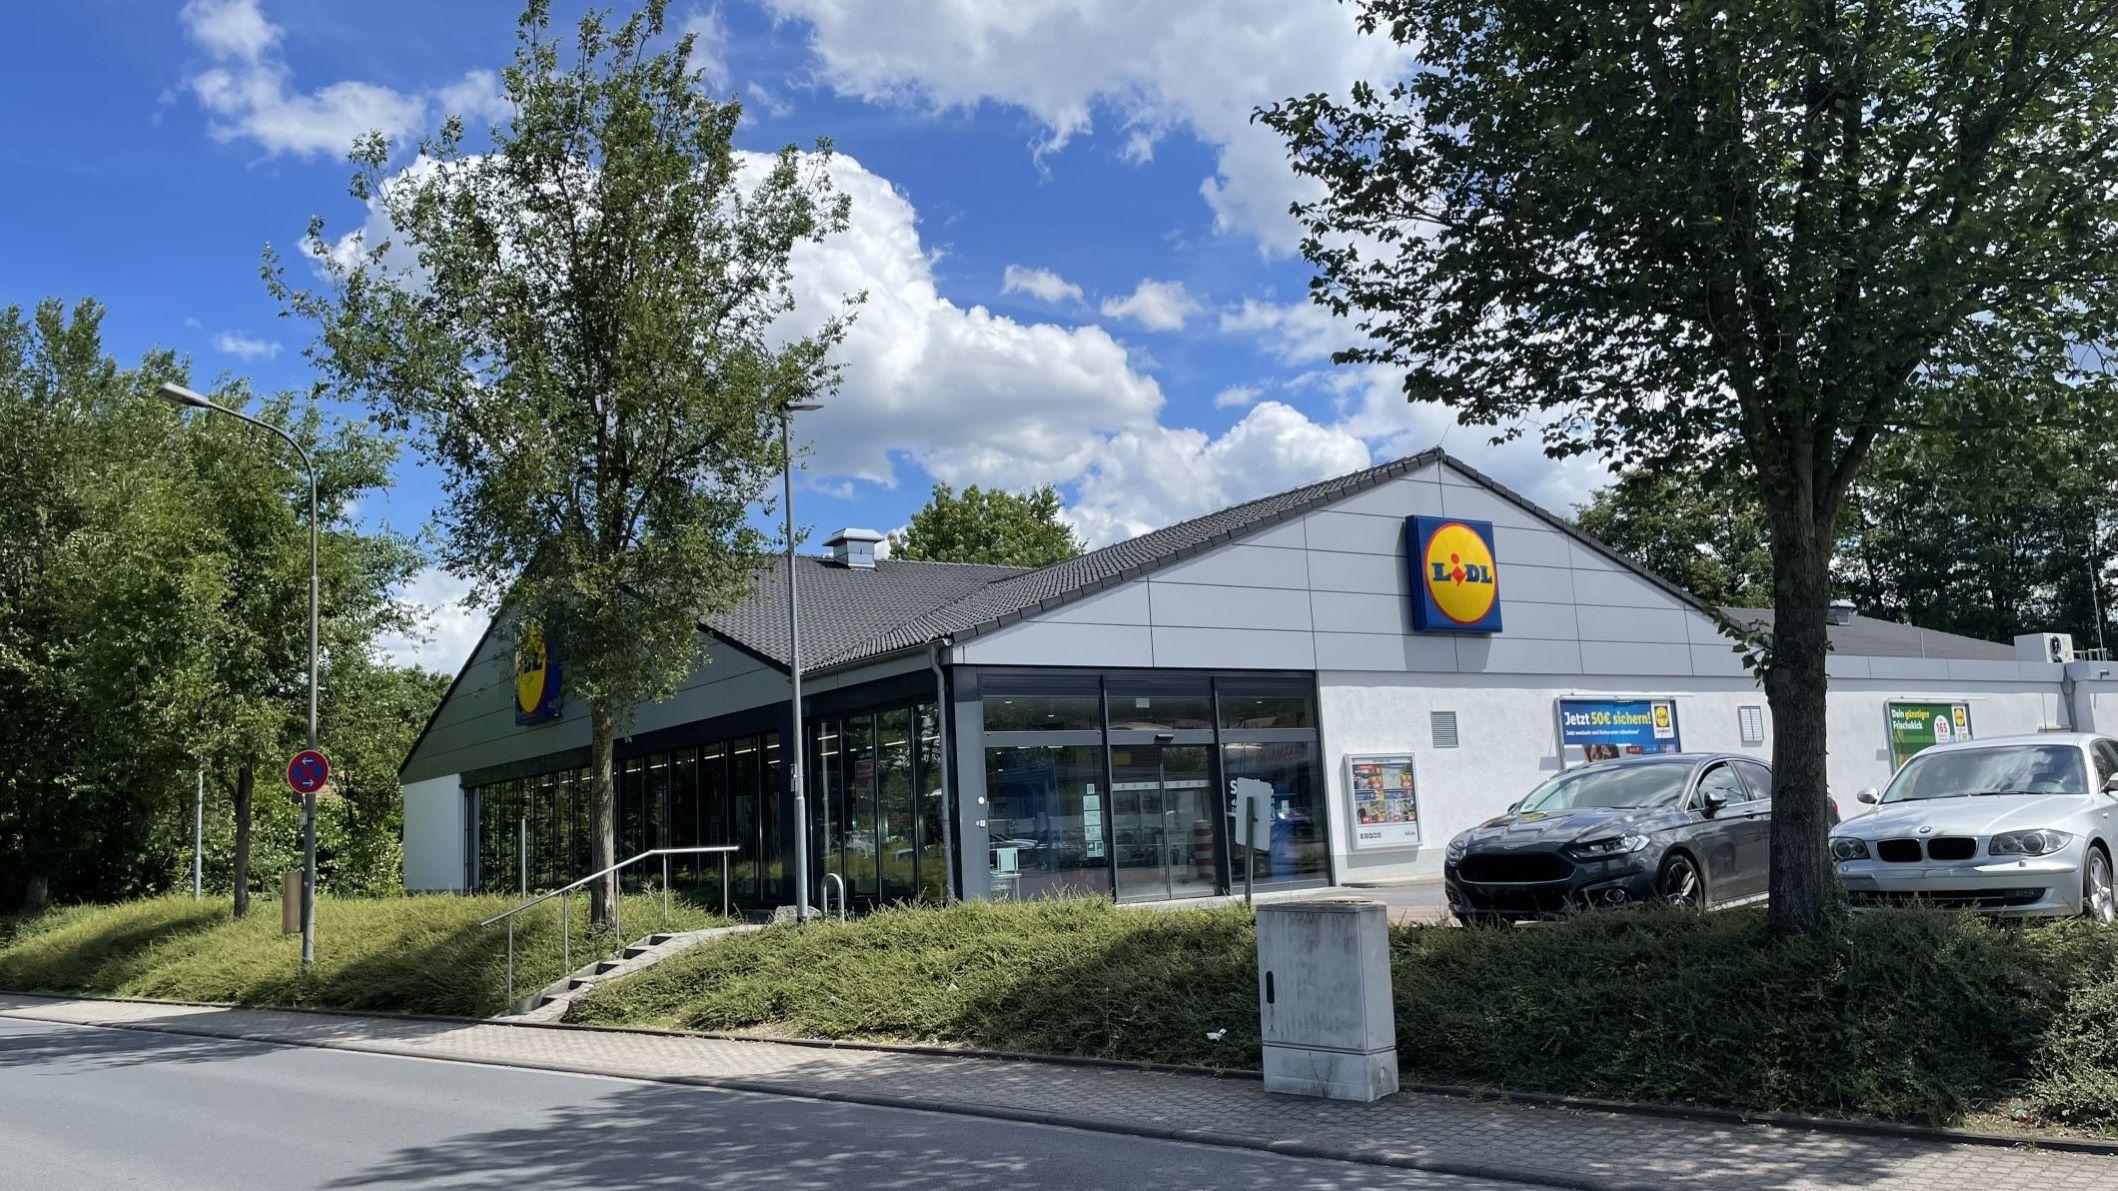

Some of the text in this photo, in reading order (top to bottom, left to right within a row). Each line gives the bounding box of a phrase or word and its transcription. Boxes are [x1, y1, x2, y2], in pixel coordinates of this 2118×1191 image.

[1565, 710, 1652, 726] Jetzt 50€ sichern!
[1891, 709, 1904, 718] Dein
[1893, 720, 1923, 730] Frischekick
